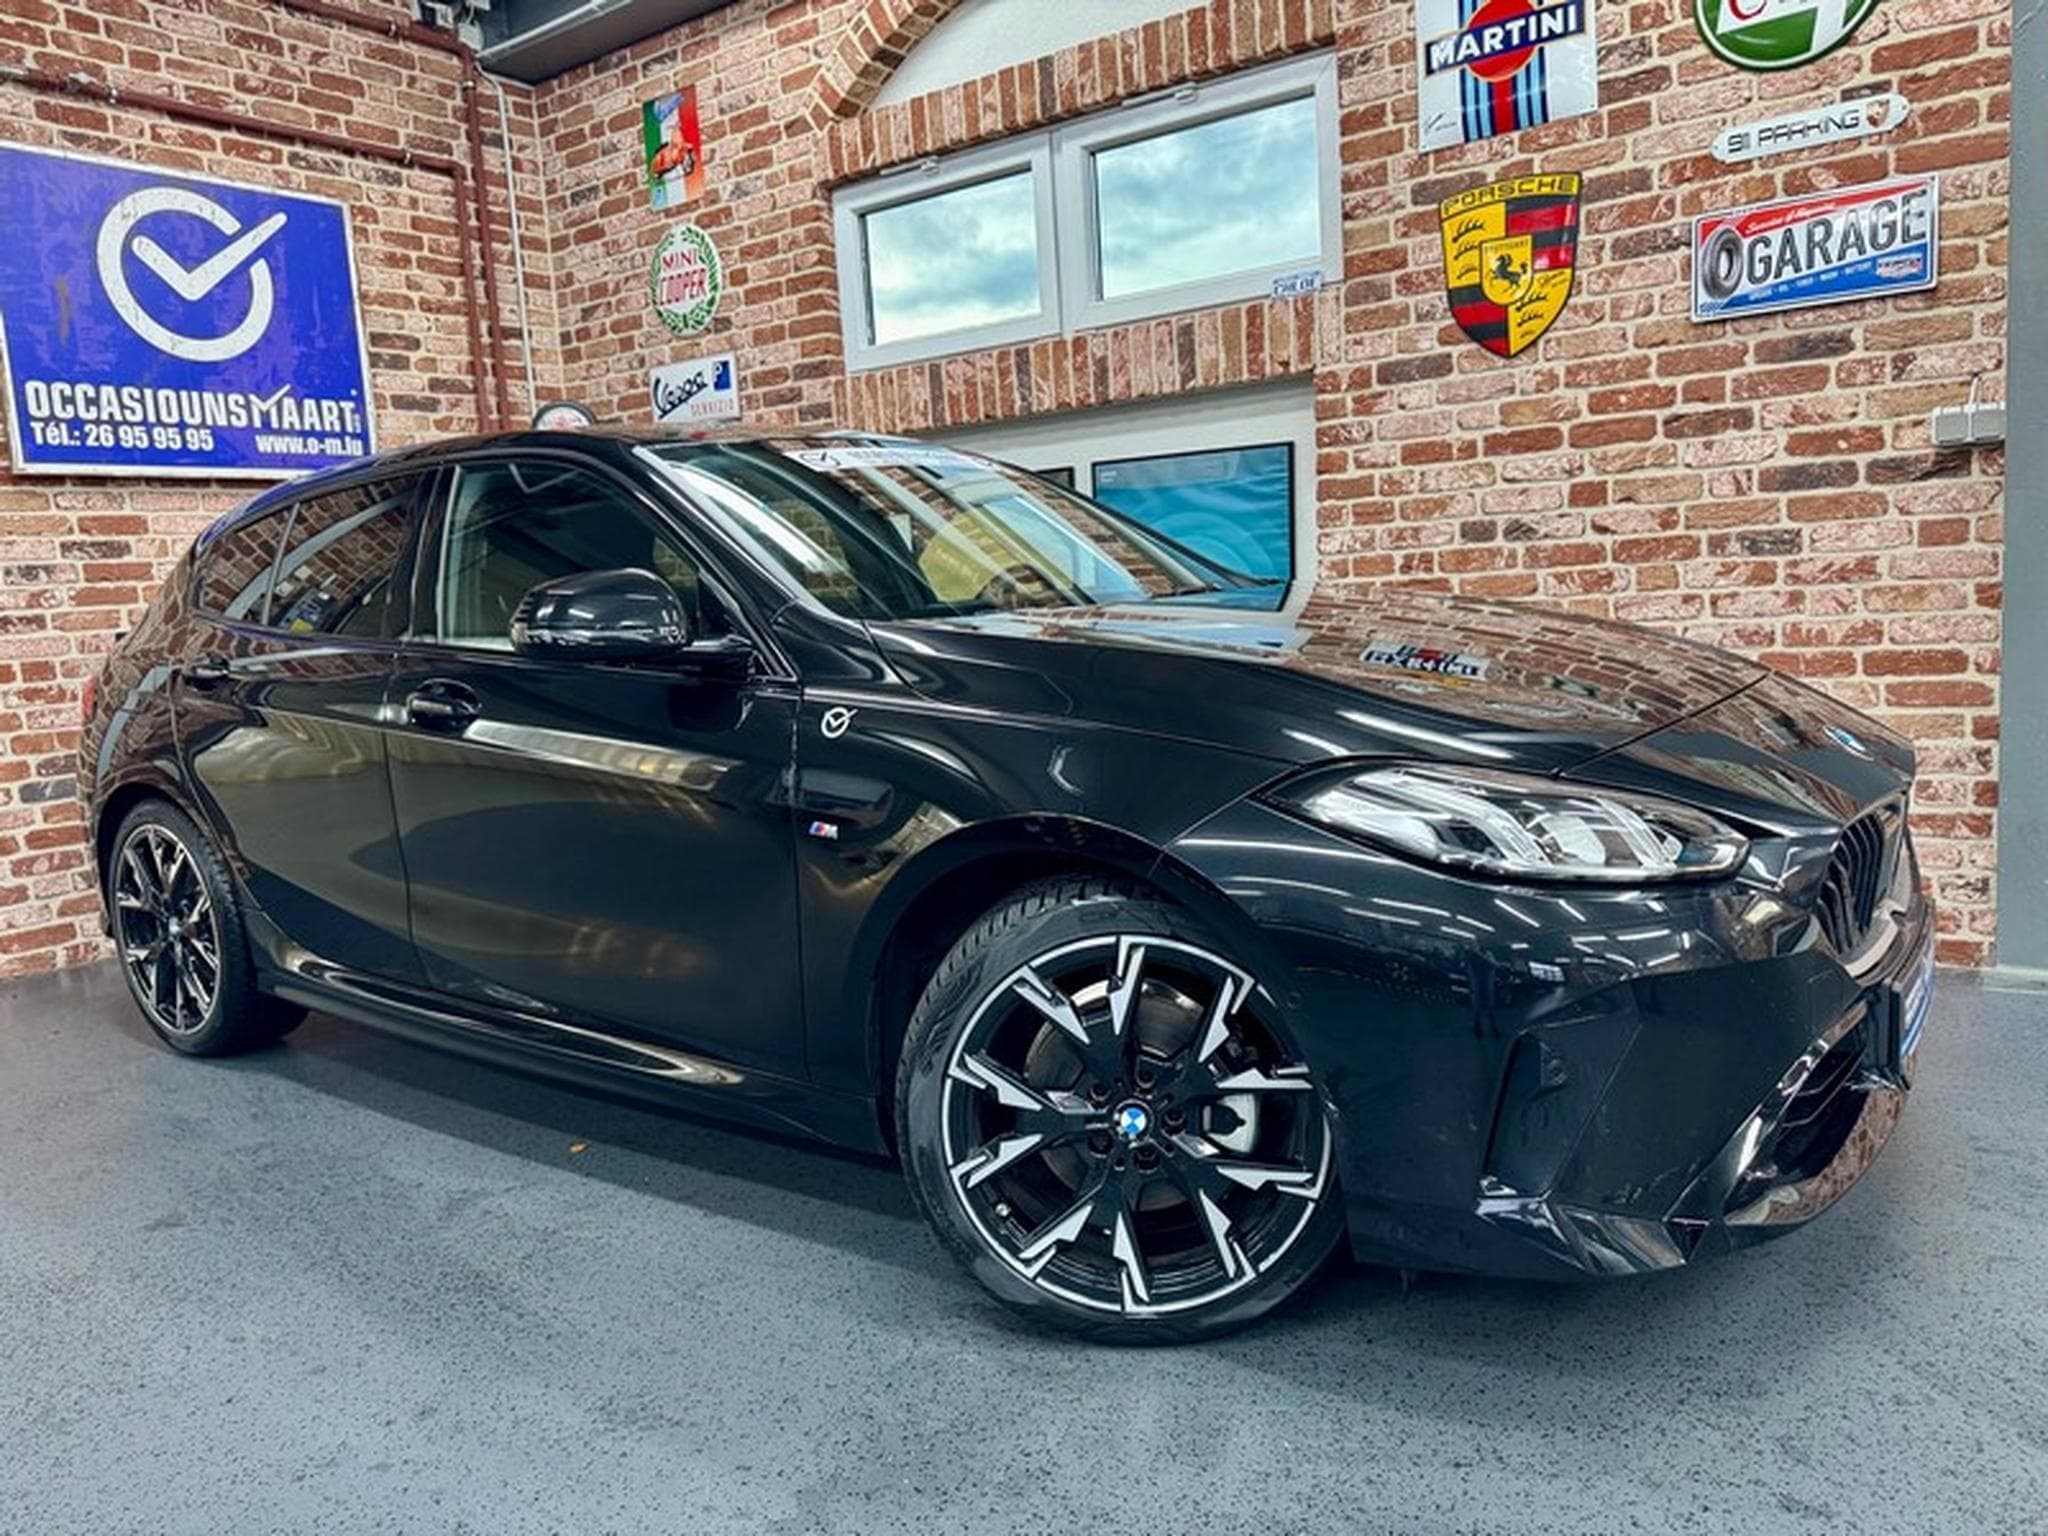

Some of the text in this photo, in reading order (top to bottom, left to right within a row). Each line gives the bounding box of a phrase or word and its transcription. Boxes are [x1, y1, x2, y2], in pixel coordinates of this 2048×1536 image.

[1429, 5, 1577, 70] MARTINI
[1757, 110, 1860, 147] PARKING
[1443, 175, 1574, 216] PORSCHE
[1746, 188, 1927, 285] GARAGE
[661, 248, 698, 272] MINI
[30, 421, 215, 452] Tél.: 26 95 95 95
[255, 434, 363, 457] www.o-m.lu
